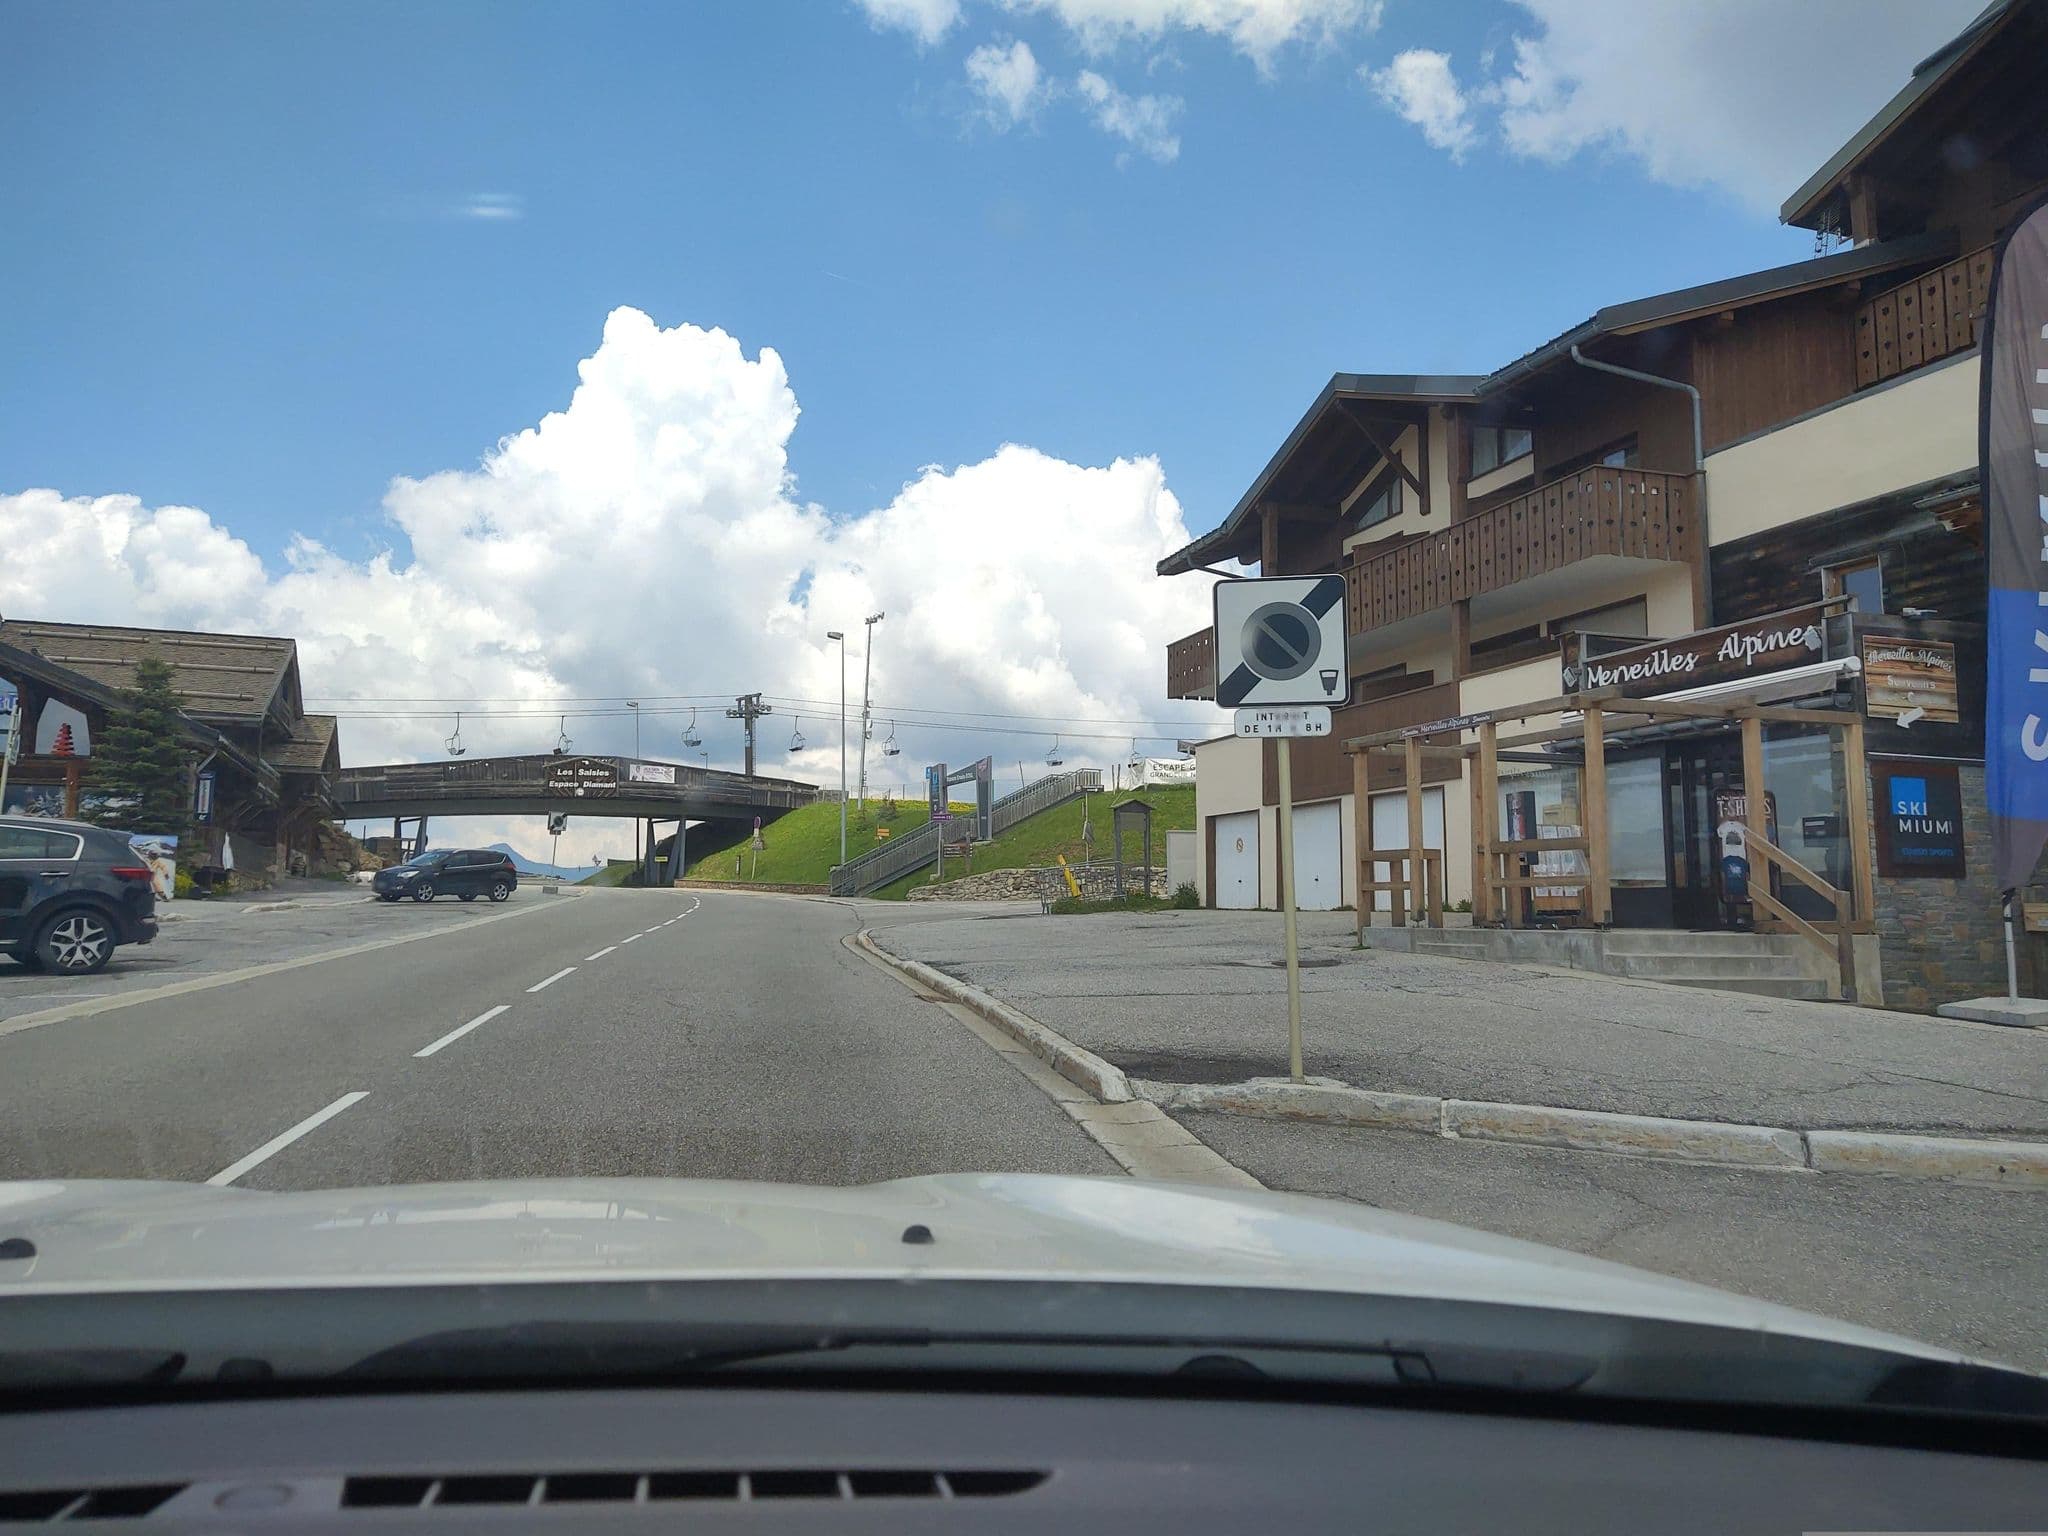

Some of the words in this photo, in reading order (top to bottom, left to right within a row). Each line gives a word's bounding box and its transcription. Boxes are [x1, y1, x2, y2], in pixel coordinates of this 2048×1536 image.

[1587, 652, 1700, 689] Merveilles
[1718, 624, 1815, 665] Alpine
[1918, 649, 1953, 673] Alpines
[1244, 724, 1260, 734] DE
[583, 780, 616, 789] Diamant
[1717, 798, 1771, 817] T-SHIS
[1897, 801, 1928, 816] SKI
[1899, 818, 1949, 834] MIUM
